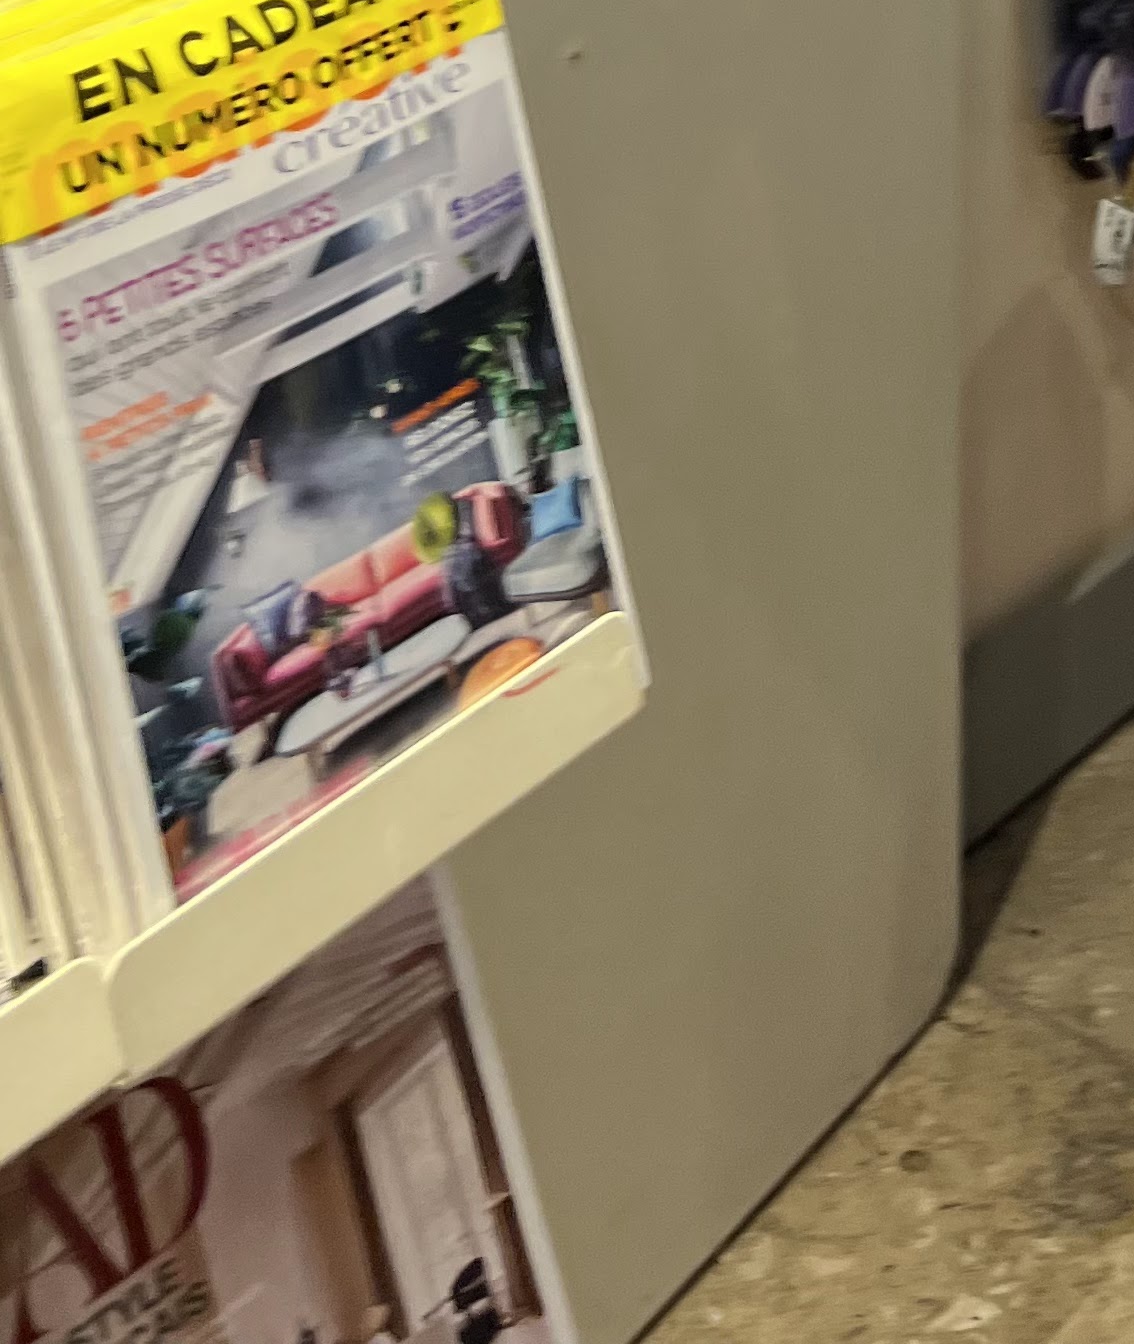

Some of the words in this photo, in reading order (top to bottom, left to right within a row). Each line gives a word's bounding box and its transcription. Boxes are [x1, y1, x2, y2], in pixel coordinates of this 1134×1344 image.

[60, 139, 126, 194] UN
[310, 8, 431, 90] OFFERT
[70, 47, 162, 122] EN
